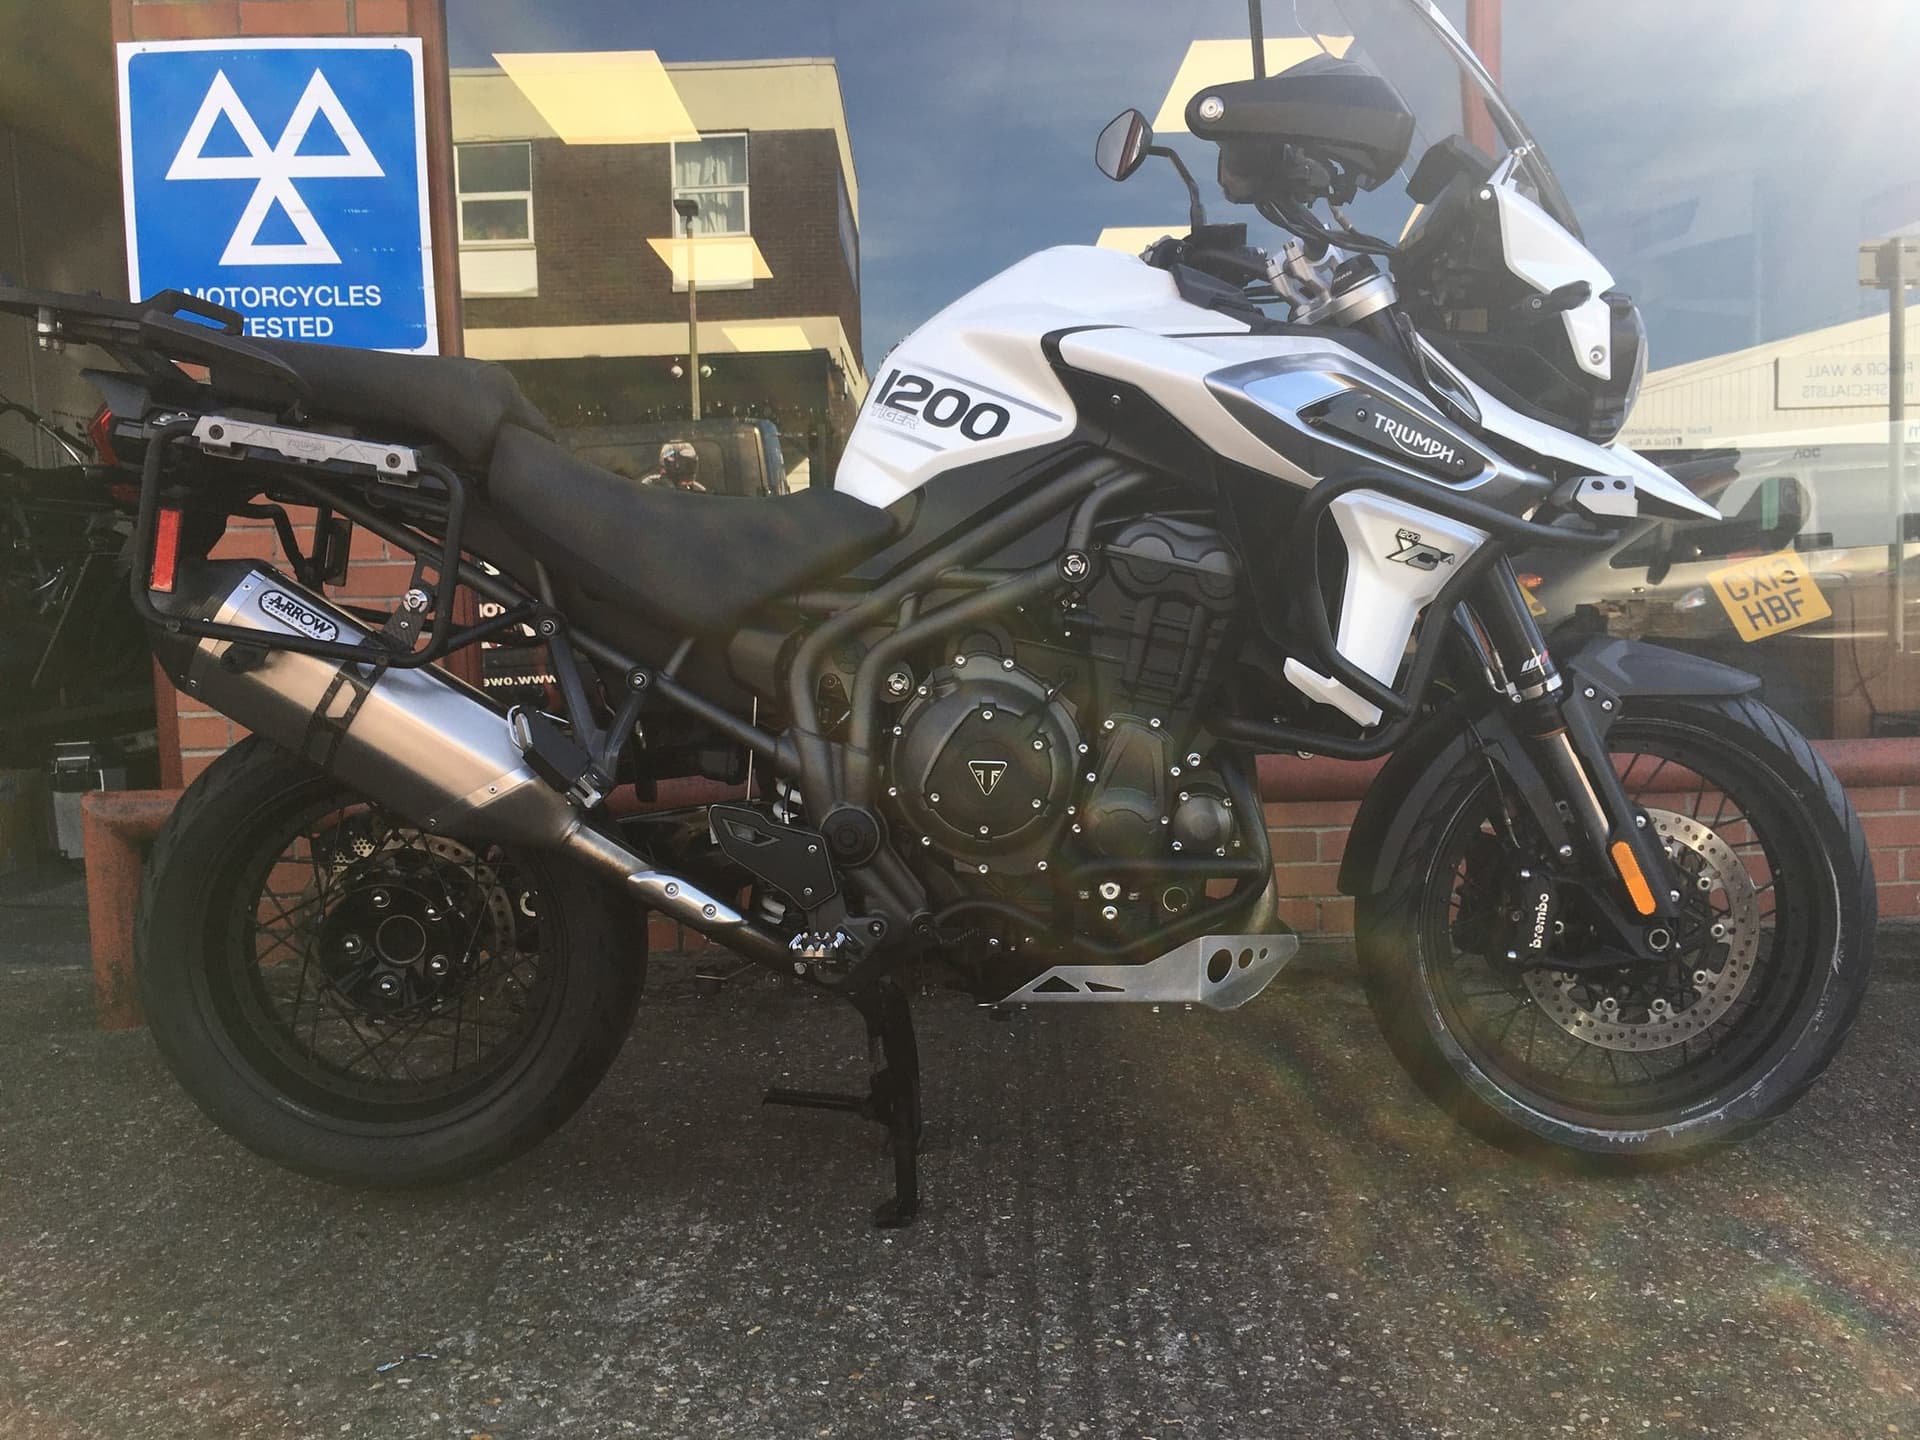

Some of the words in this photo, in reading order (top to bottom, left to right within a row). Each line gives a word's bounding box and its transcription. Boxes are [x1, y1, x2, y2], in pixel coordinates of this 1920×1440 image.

[871, 404, 920, 429] TIGER
[874, 369, 1010, 441] 1200
[1375, 413, 1455, 463] TRIUMPH
[268, 595, 332, 634] ARROW
[1742, 588, 1804, 631] HBF
[1529, 893, 1549, 949] brembo
